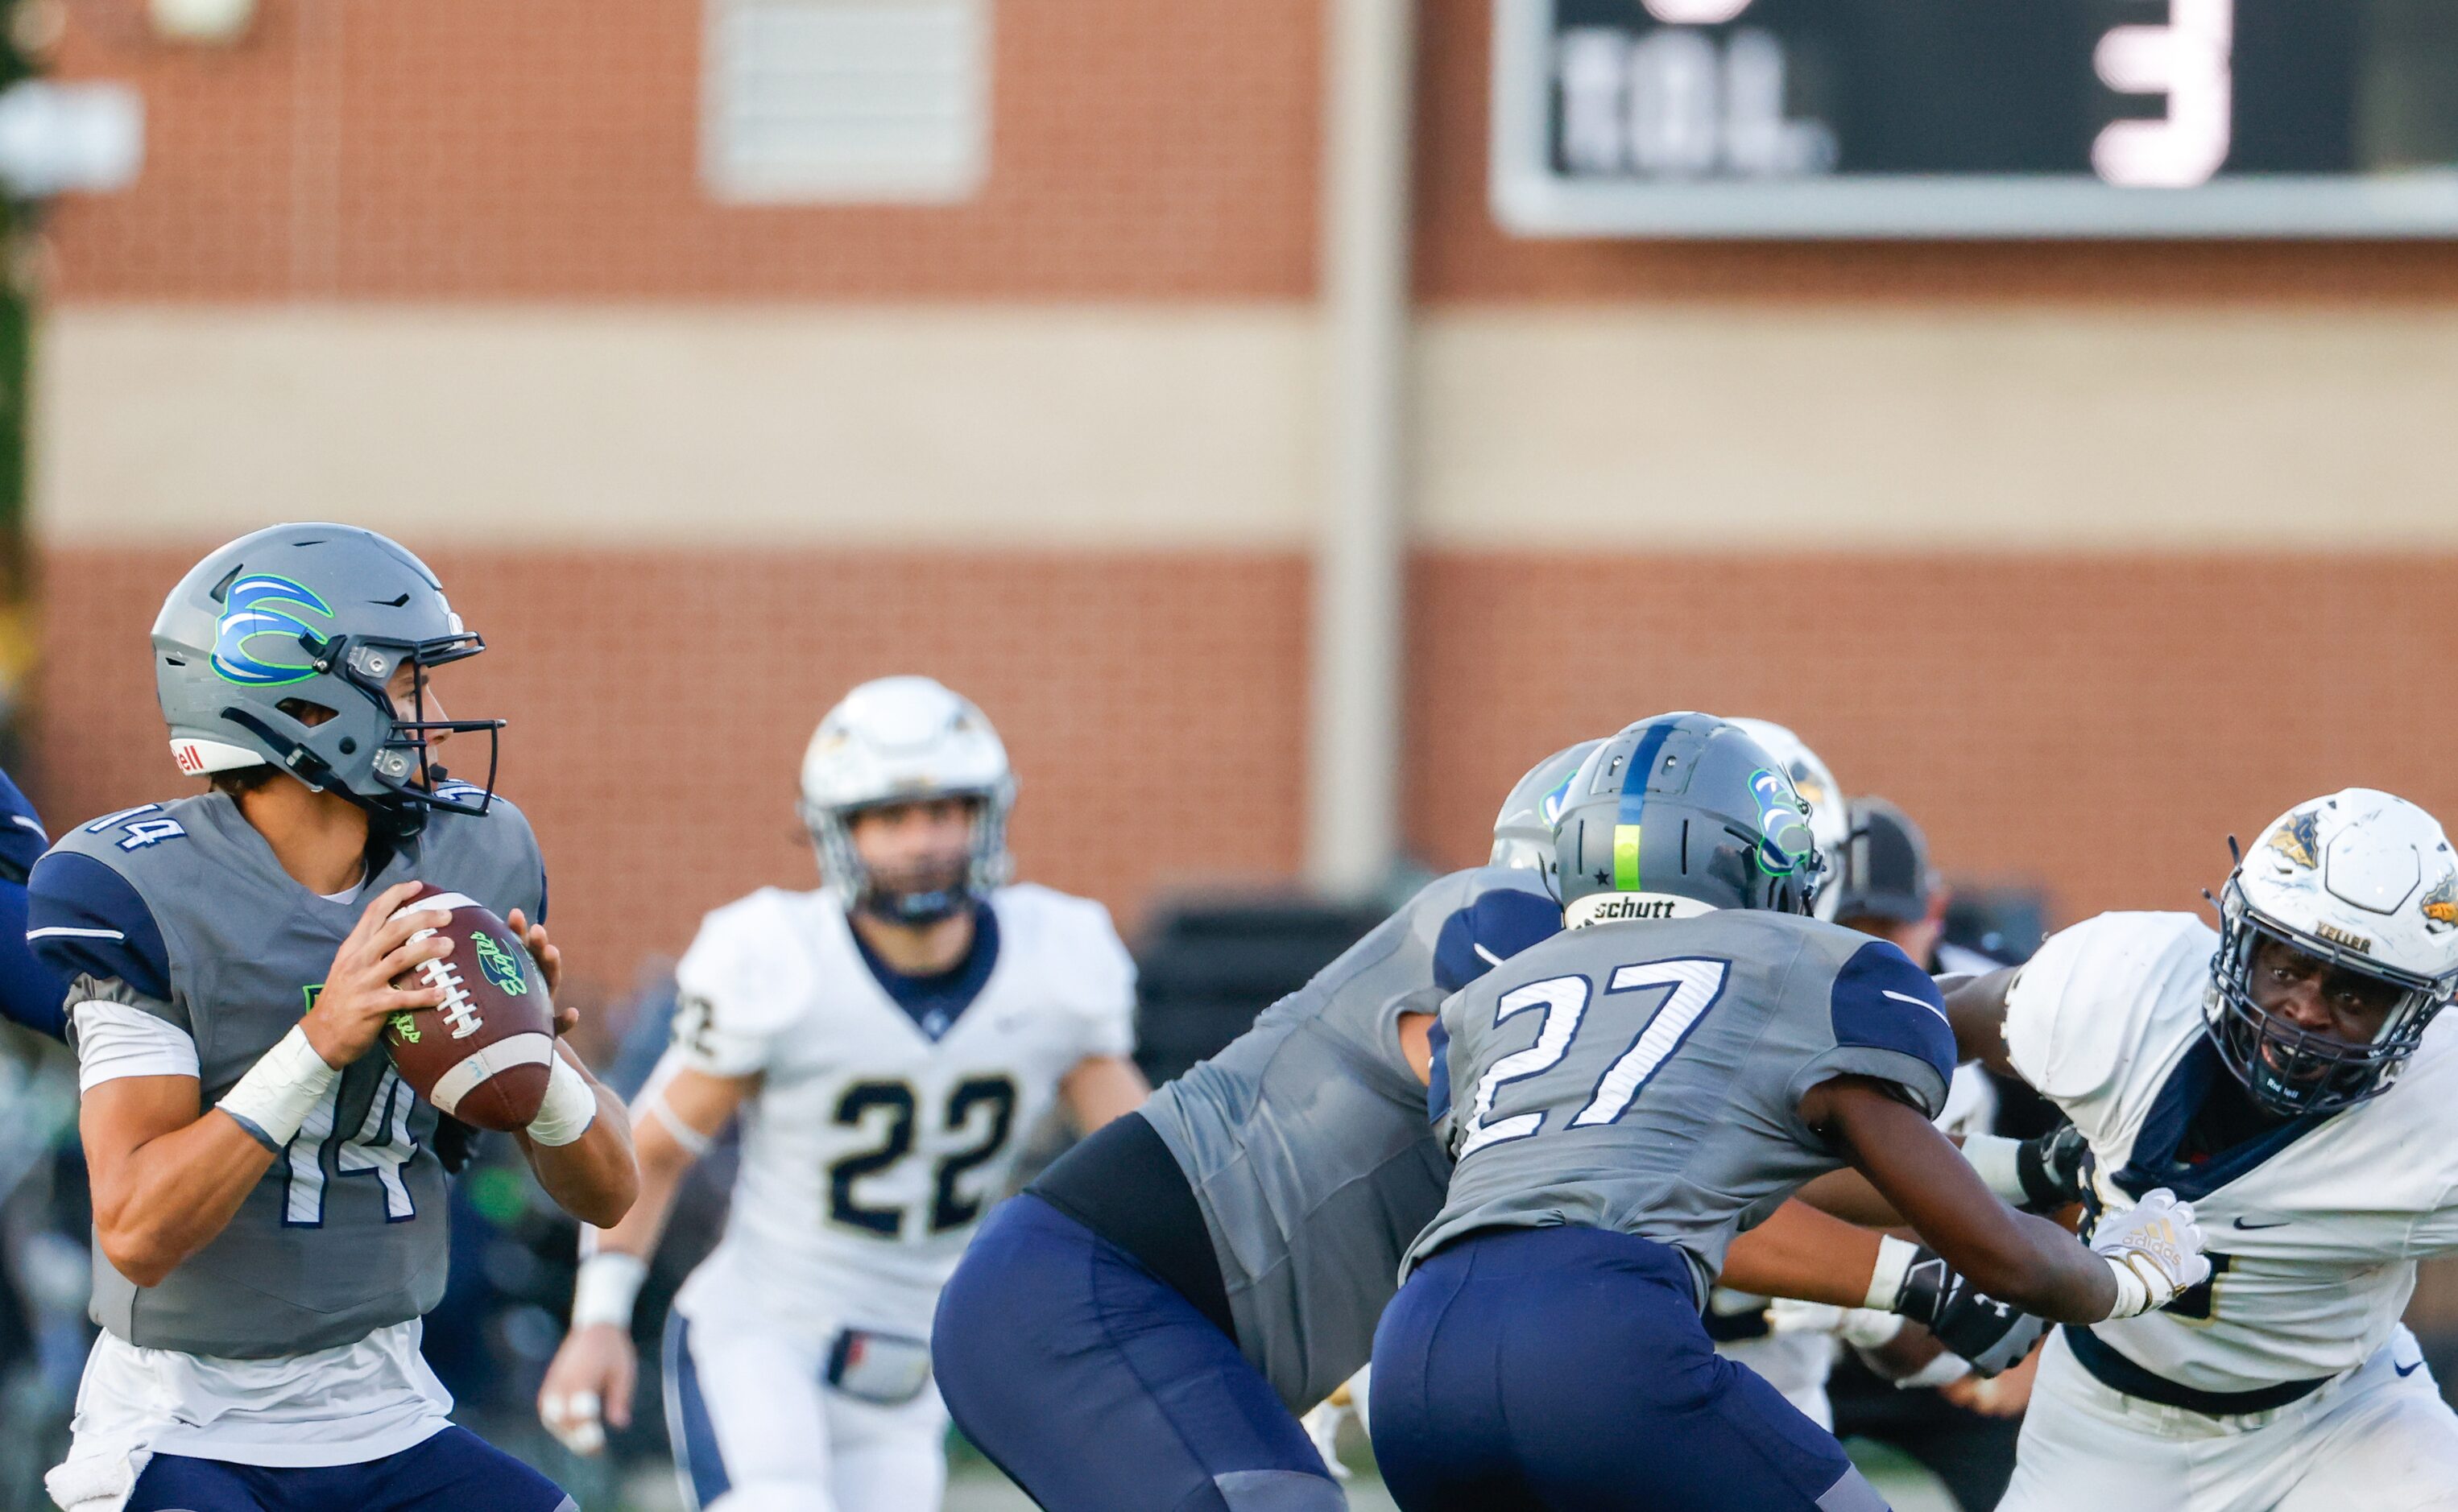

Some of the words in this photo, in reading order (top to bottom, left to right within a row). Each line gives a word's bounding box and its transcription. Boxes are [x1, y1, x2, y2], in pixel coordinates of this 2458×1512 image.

[2092, 0, 2234, 188] 3
[84, 803, 187, 853] 14
[1594, 896, 1675, 919] schutt
[2315, 920, 2371, 955] KELLER
[470, 930, 528, 997] Eagles
[1455, 955, 1732, 1164] 27
[282, 1061, 419, 1229] 14
[823, 1071, 1017, 1240] 22
[2122, 1234, 2183, 1267] adidas
